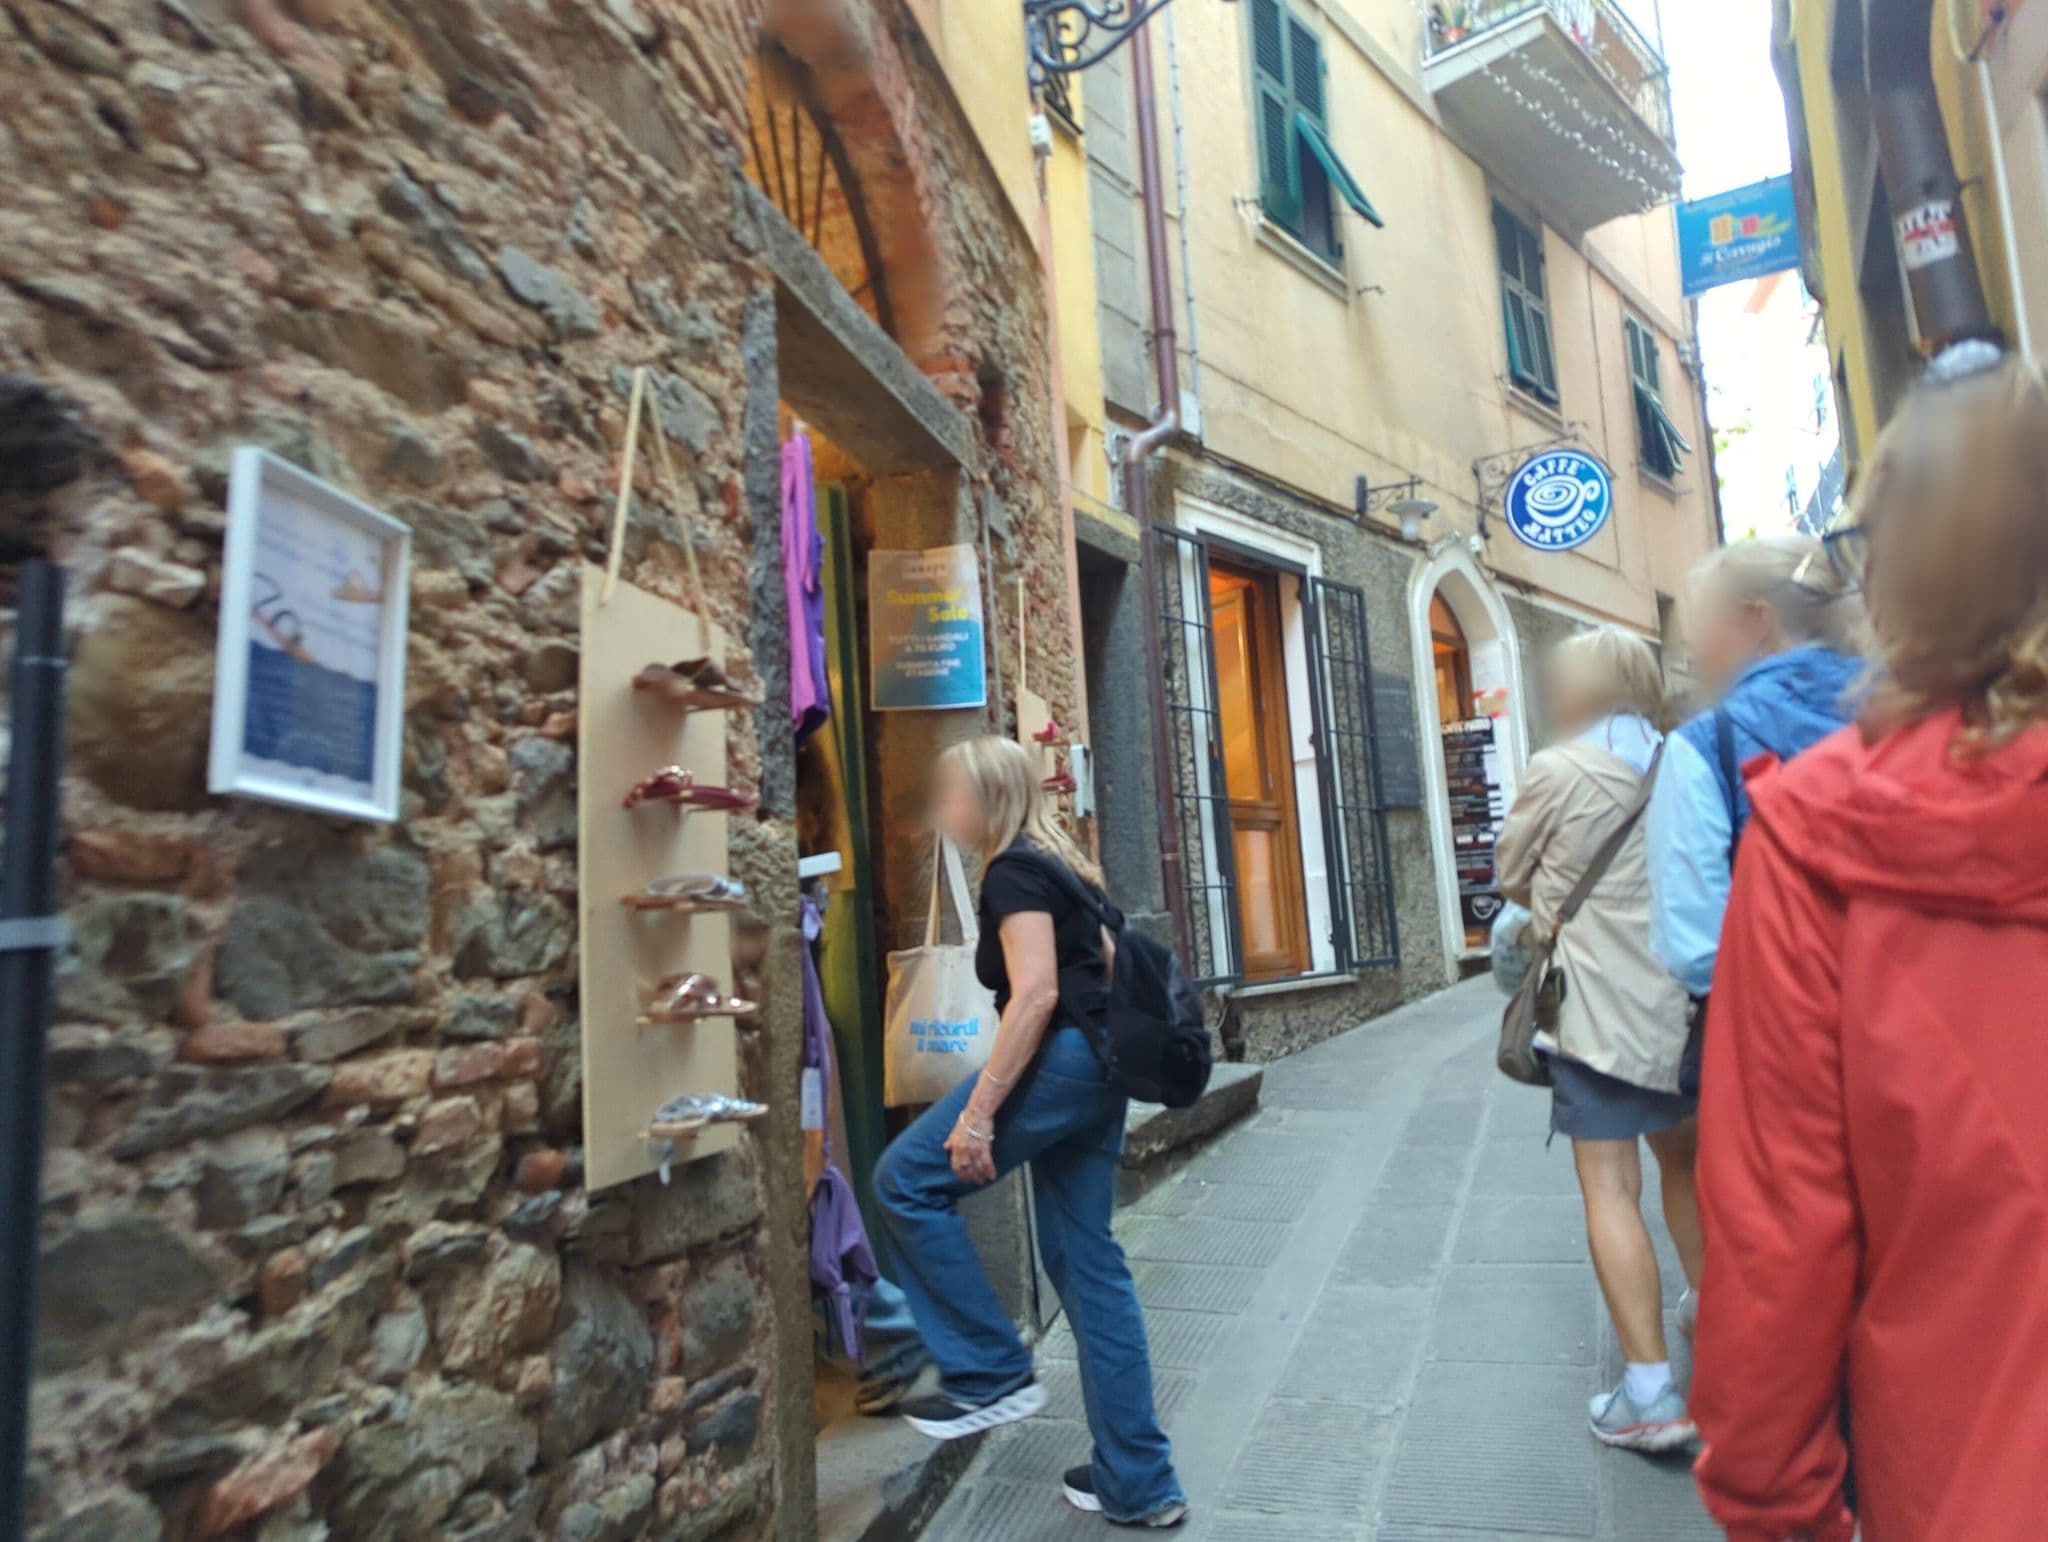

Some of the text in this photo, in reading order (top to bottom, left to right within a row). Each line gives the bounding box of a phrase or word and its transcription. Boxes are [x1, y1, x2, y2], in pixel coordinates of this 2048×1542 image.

[1522, 509, 1596, 543] MATTEO
[888, 589, 961, 605] Summer
[928, 606, 969, 623] Sale
[929, 1017, 978, 1035] ricordi
[927, 1039, 968, 1052] mare
